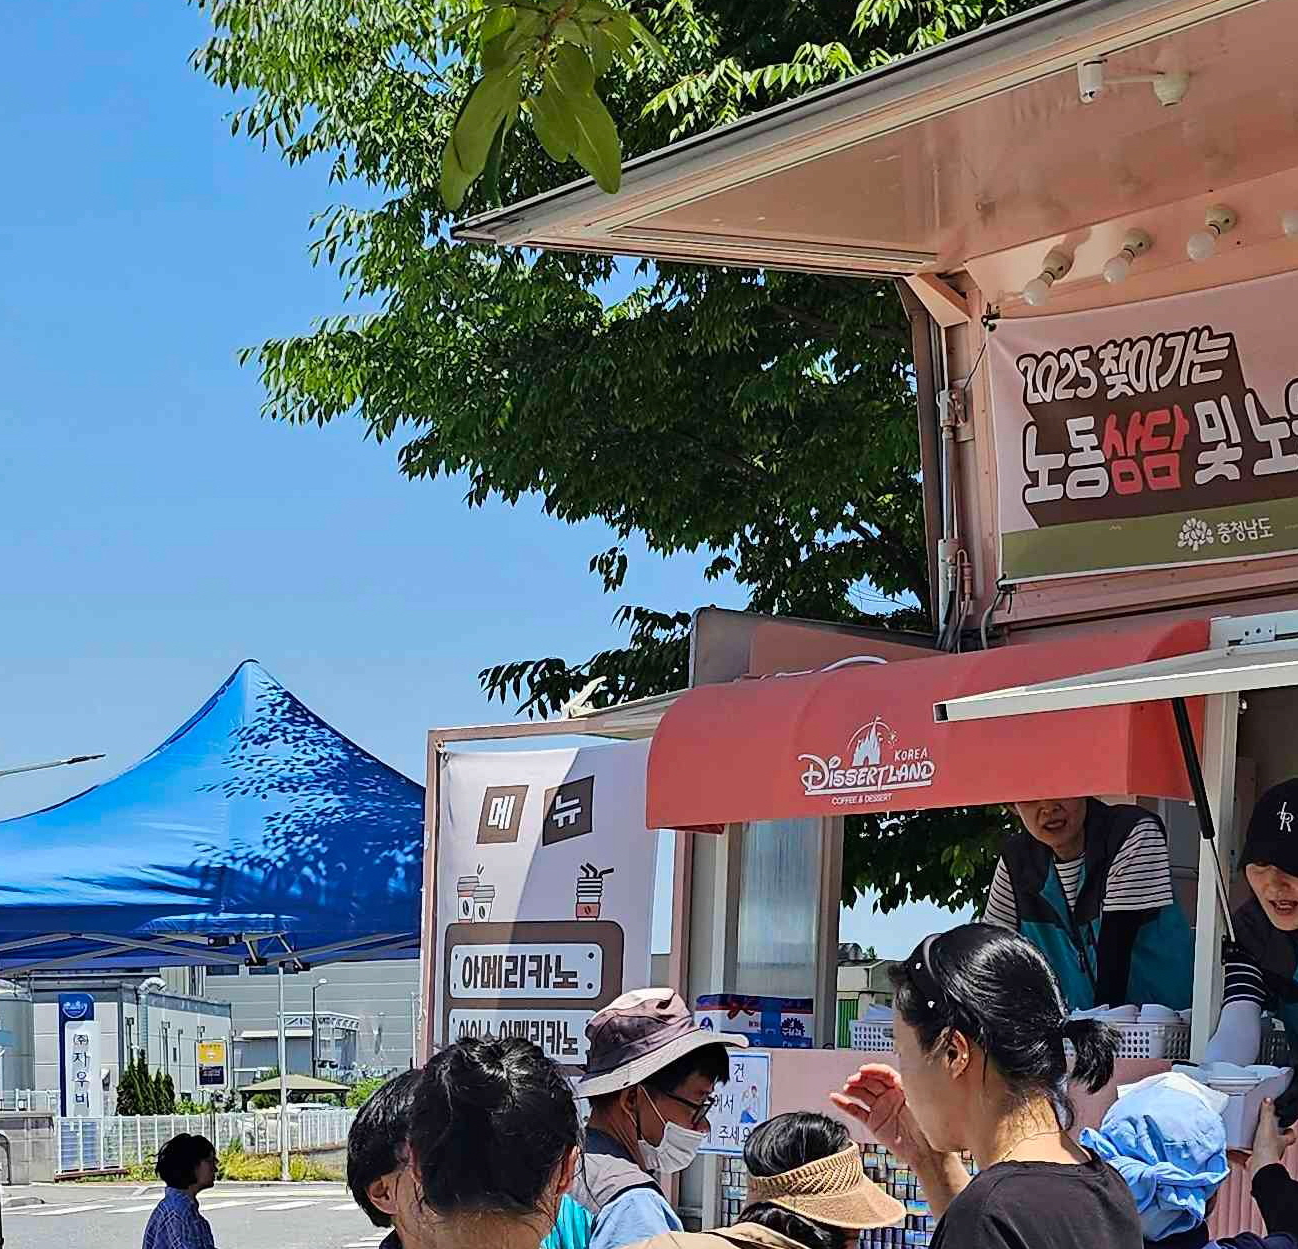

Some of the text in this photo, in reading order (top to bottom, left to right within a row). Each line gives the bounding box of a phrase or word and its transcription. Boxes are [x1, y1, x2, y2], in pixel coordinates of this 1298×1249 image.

[1018, 327, 1232, 405] 2025 찾아가는
[1023, 403, 1191, 505] 노동상담
[1193, 393, 1243, 486] 및
[1216, 516, 1275, 545] 충청남도
[894, 747, 928, 762] KOREA
[462, 953, 579, 990] 아메리카노
